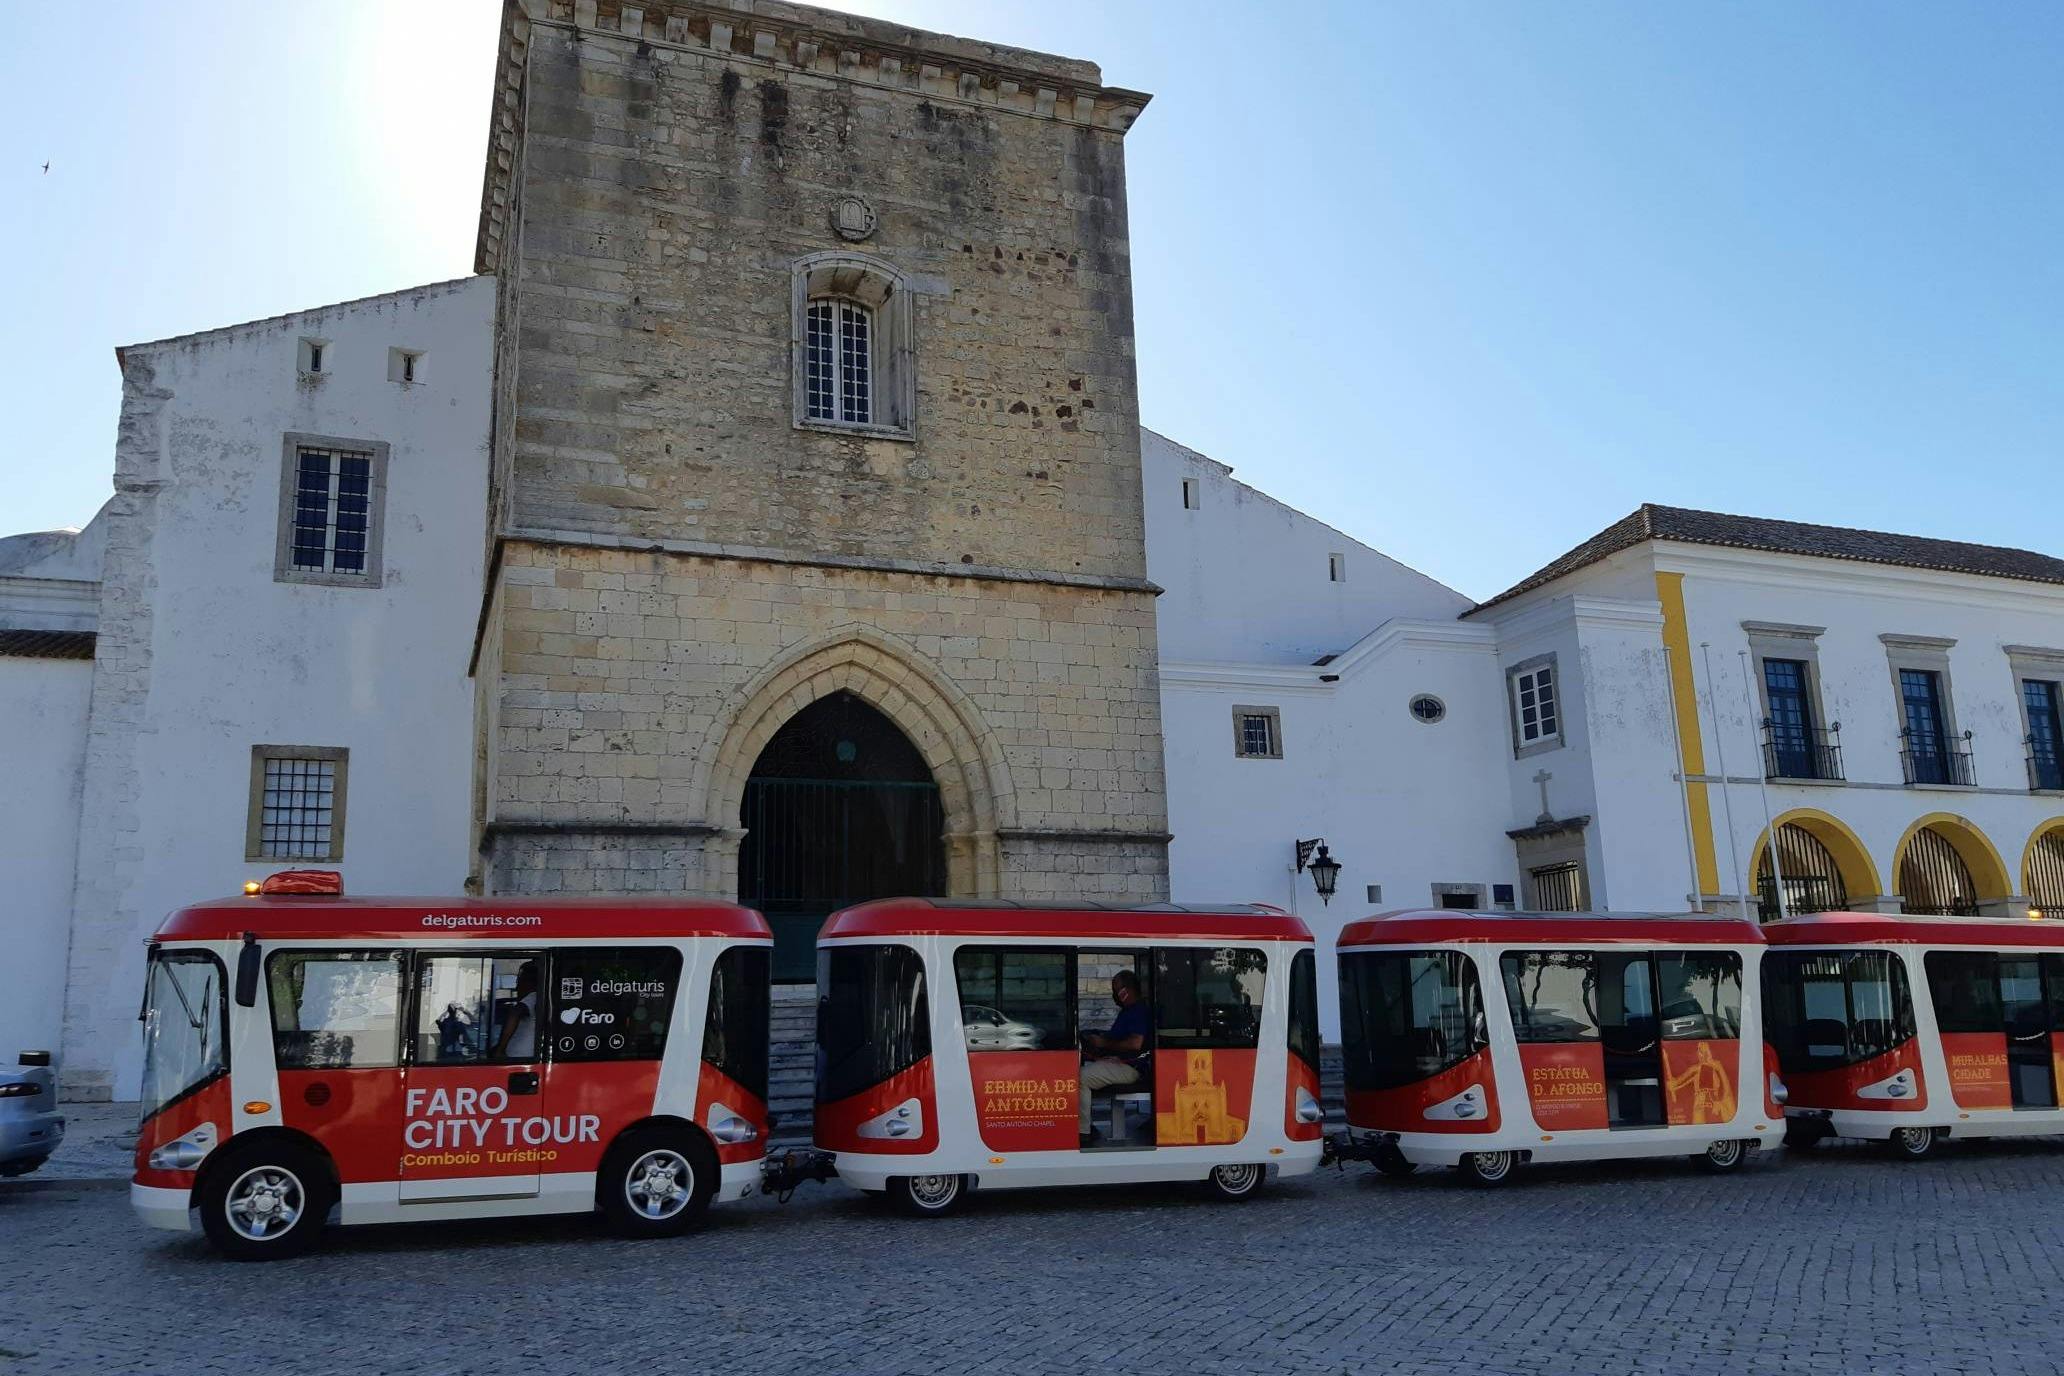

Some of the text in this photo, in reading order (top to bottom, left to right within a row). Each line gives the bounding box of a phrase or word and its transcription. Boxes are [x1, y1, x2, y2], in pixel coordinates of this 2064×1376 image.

[422, 914, 542, 928] delgaturis.com
[591, 980, 665, 996] delgaturis
[581, 1009, 615, 1024] Faro
[1533, 1064, 1589, 1080] ESTÁTUA
[985, 1080, 1077, 1094] ERMIDA DE
[1550, 1082, 1603, 1096] AFONSO
[406, 1086, 509, 1117] FARO
[985, 1094, 1068, 1112] ANTÓNIO
[405, 1115, 601, 1149] CITY TOUR
[404, 1149, 558, 1166] Comboio Turístico
